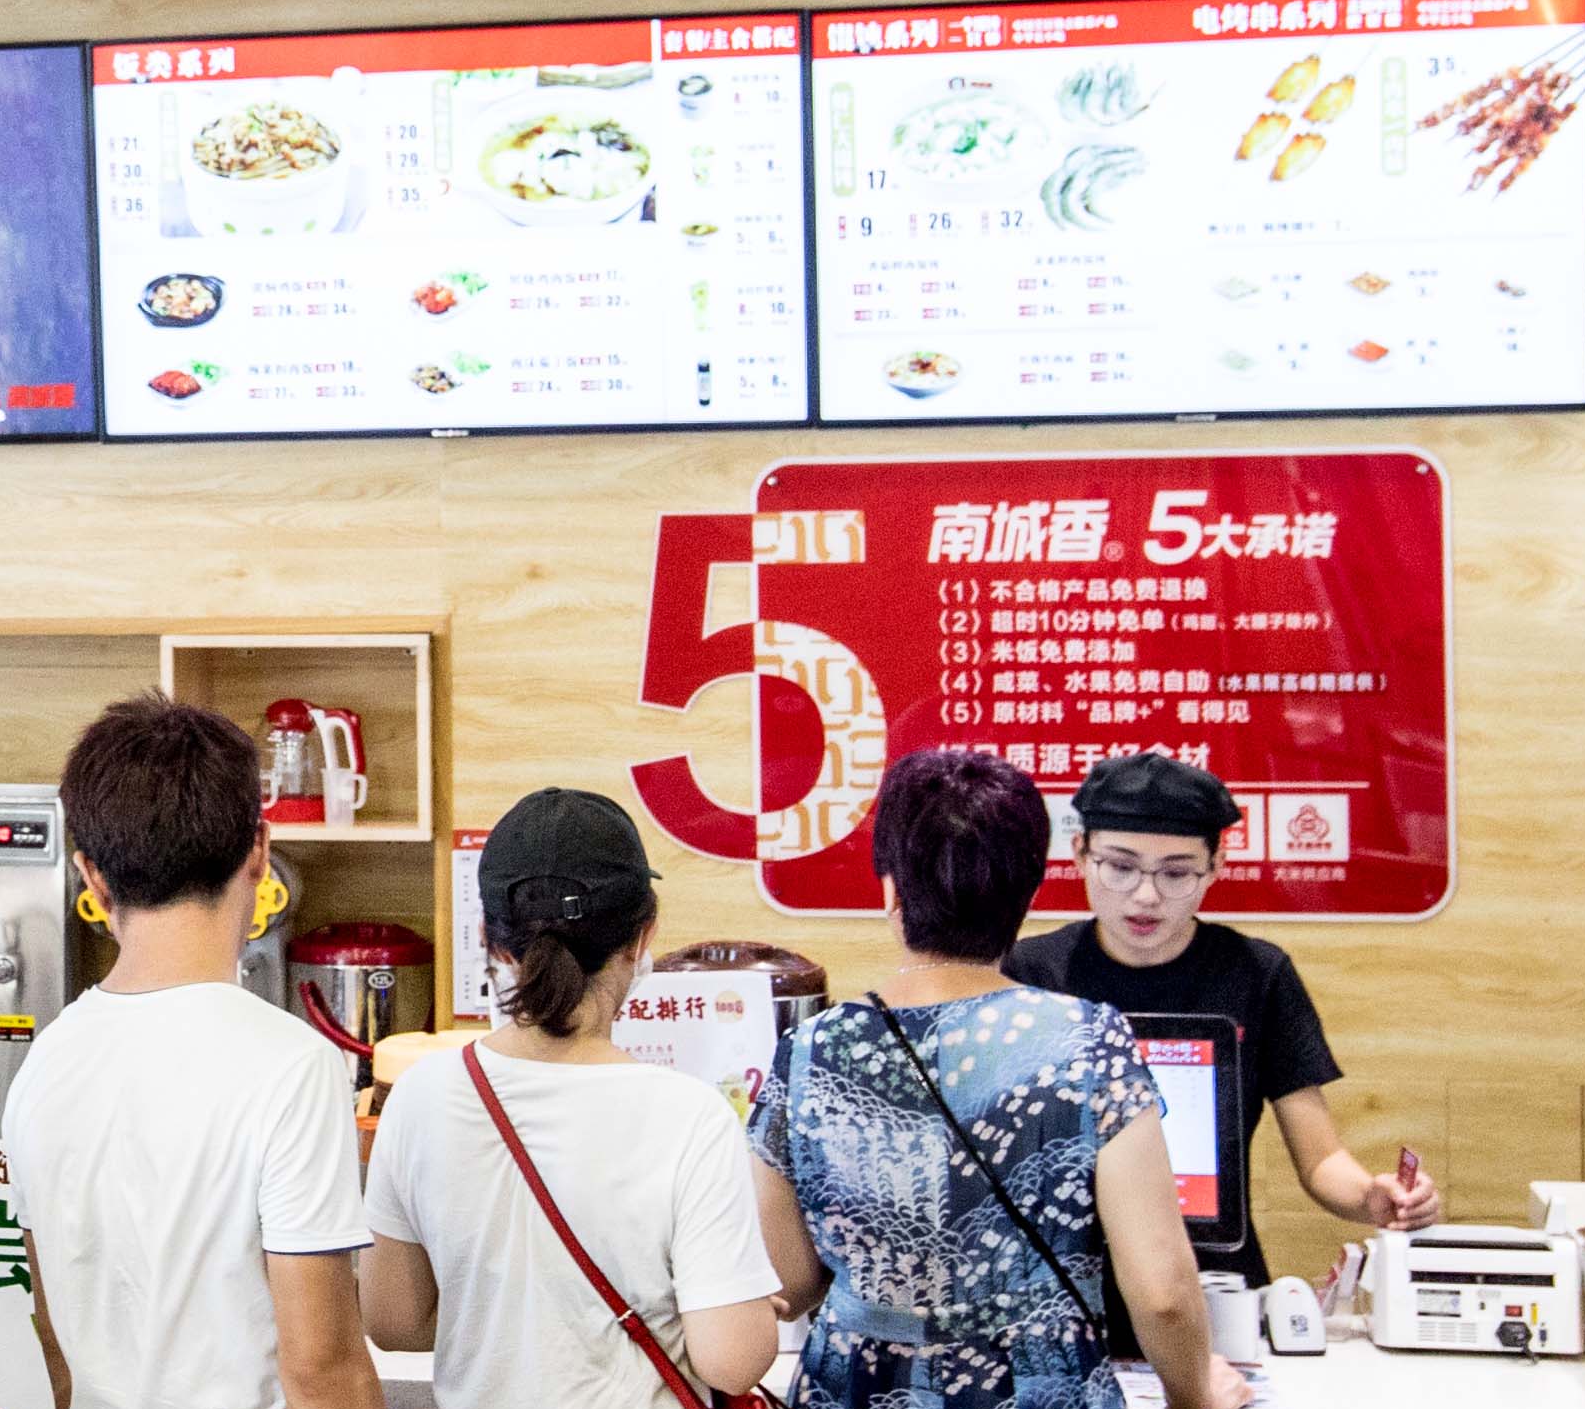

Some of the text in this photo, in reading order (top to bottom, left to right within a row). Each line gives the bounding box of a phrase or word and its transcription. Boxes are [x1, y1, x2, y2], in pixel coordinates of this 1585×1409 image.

[112, 46, 236, 80] 饭类系列
[867, 169, 887, 190] 17
[860, 217, 872, 237] 9
[929, 212, 952, 231] 26
[1000, 210, 1024, 228] 32
[927, 489, 1338, 566] 南城香 5大承诺
